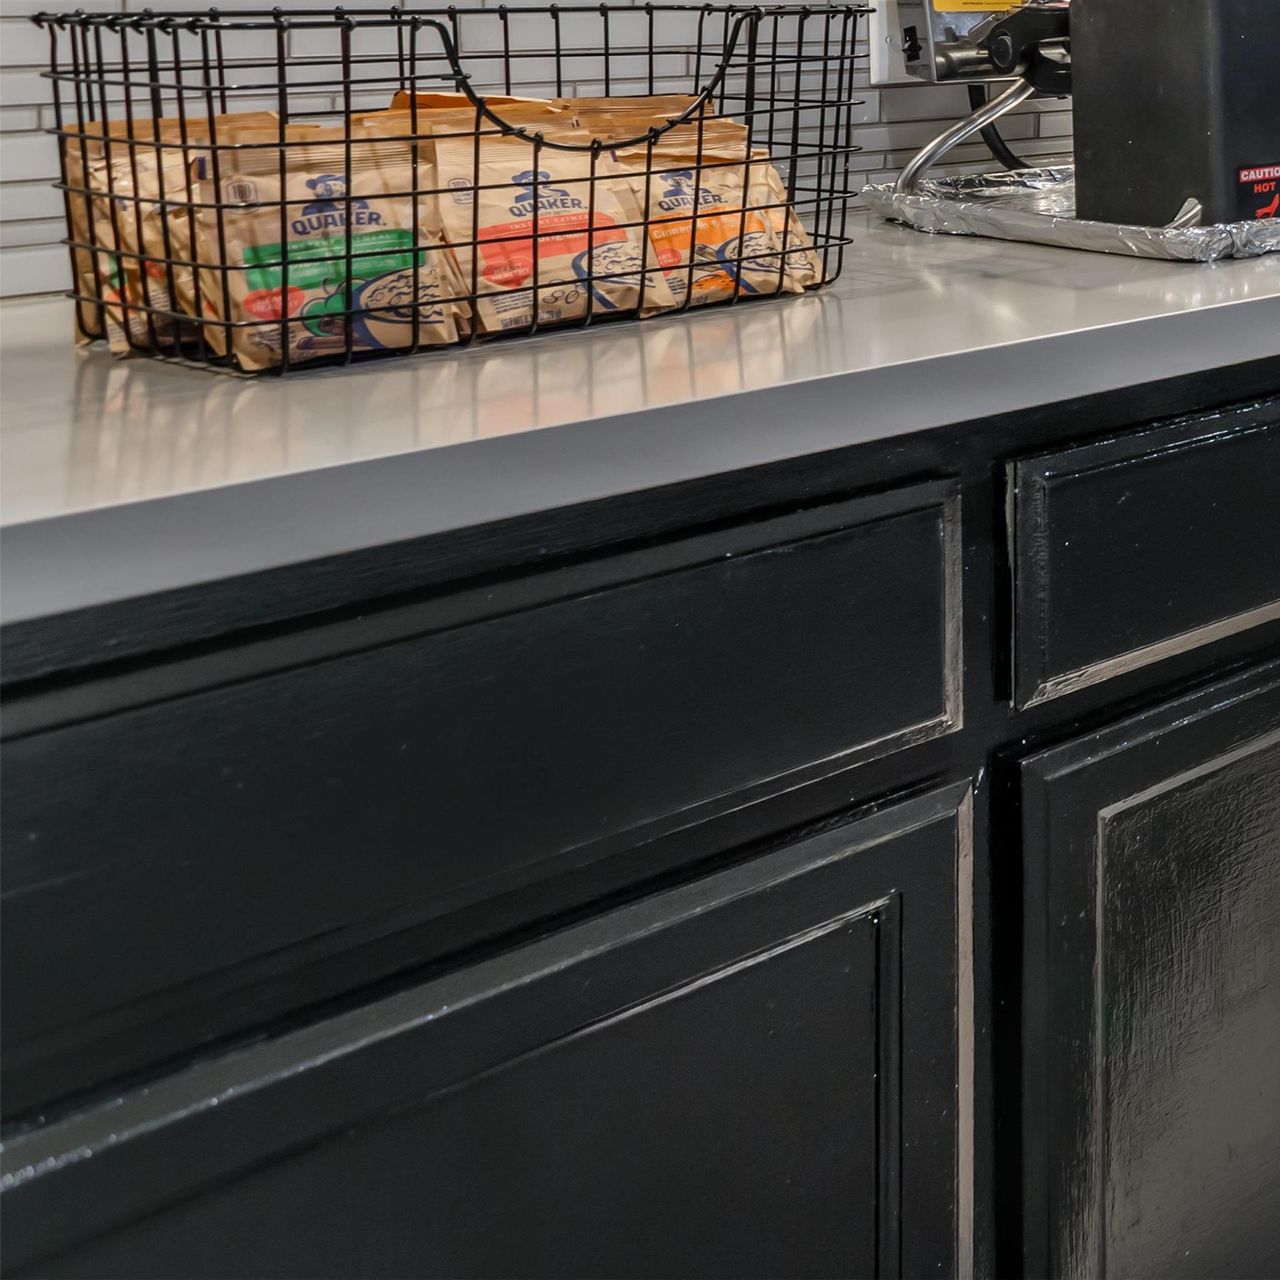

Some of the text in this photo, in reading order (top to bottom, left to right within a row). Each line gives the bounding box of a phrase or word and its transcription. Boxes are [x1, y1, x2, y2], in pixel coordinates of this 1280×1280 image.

[1253, 181, 1277, 194] HOT
[509, 197, 583, 218] QUAKER
[291, 211, 382, 236] QUAKER
